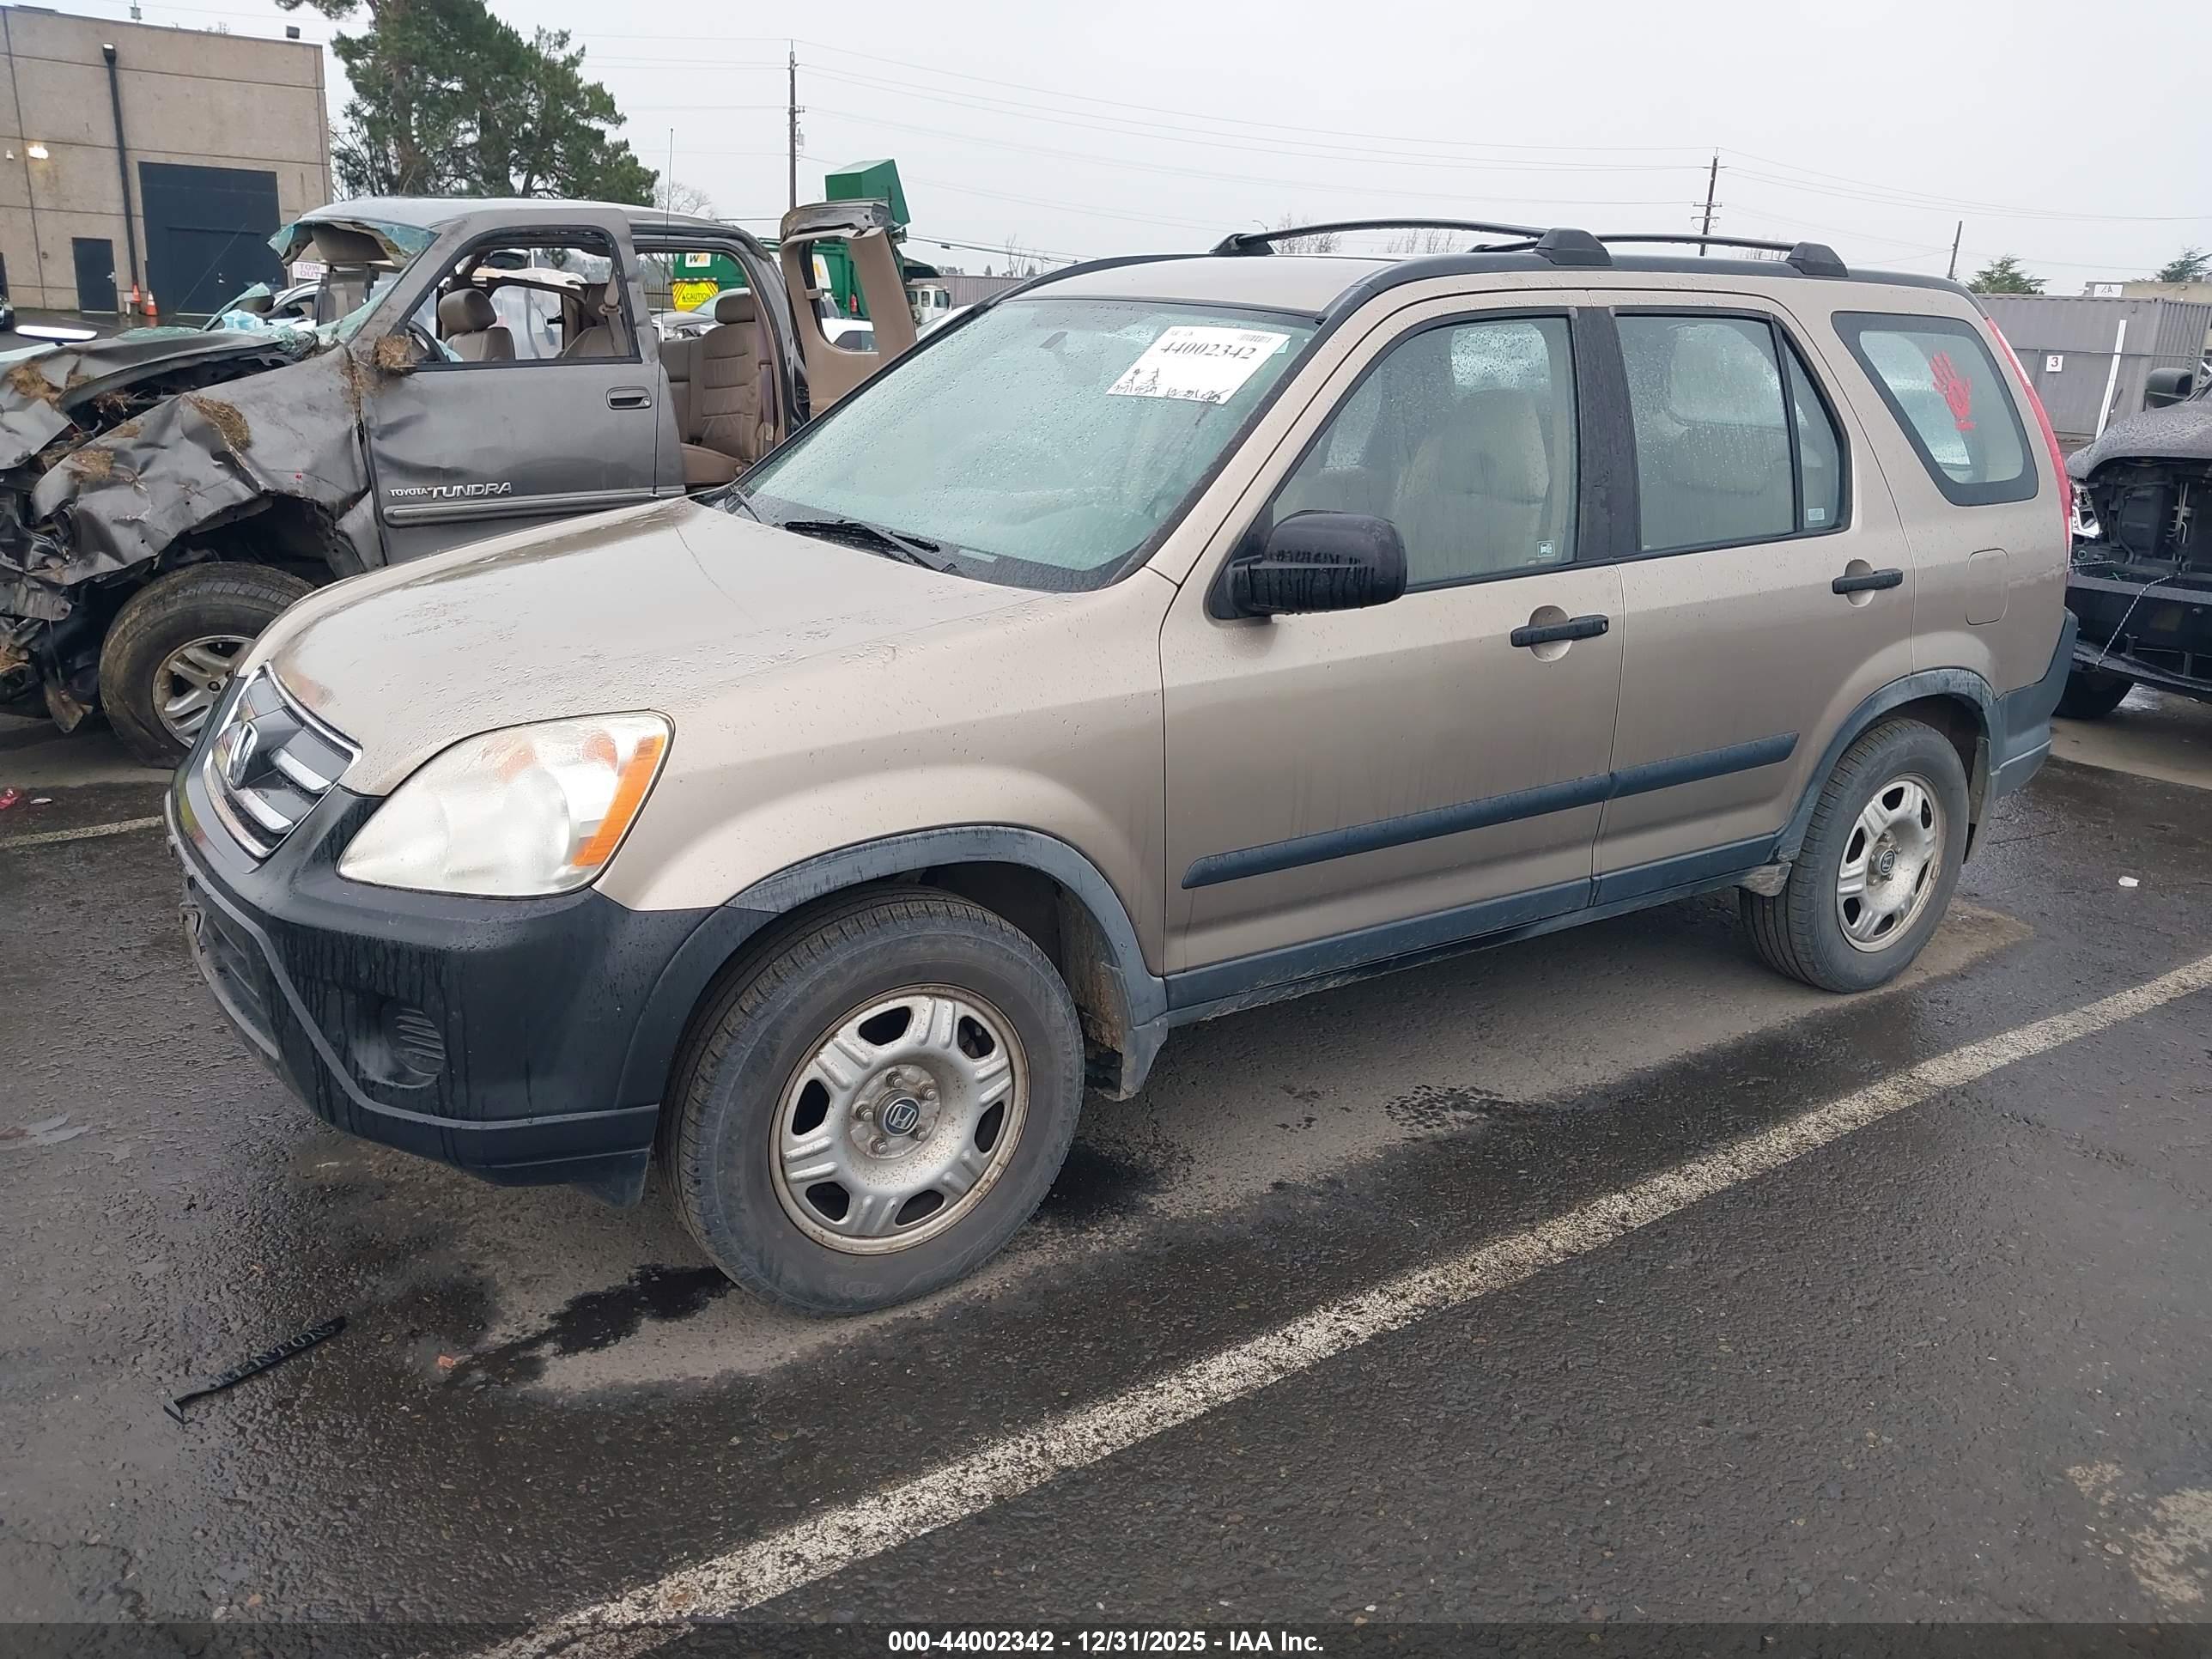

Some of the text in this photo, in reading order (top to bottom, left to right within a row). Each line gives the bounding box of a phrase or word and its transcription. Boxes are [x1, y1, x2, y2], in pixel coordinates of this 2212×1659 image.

[685, 292, 711, 301] CAUTION
[1160, 341, 1258, 360] 44002342
[2051, 356, 2059, 368] 3
[389, 482, 513, 499] TOYOTA TUNDRA
